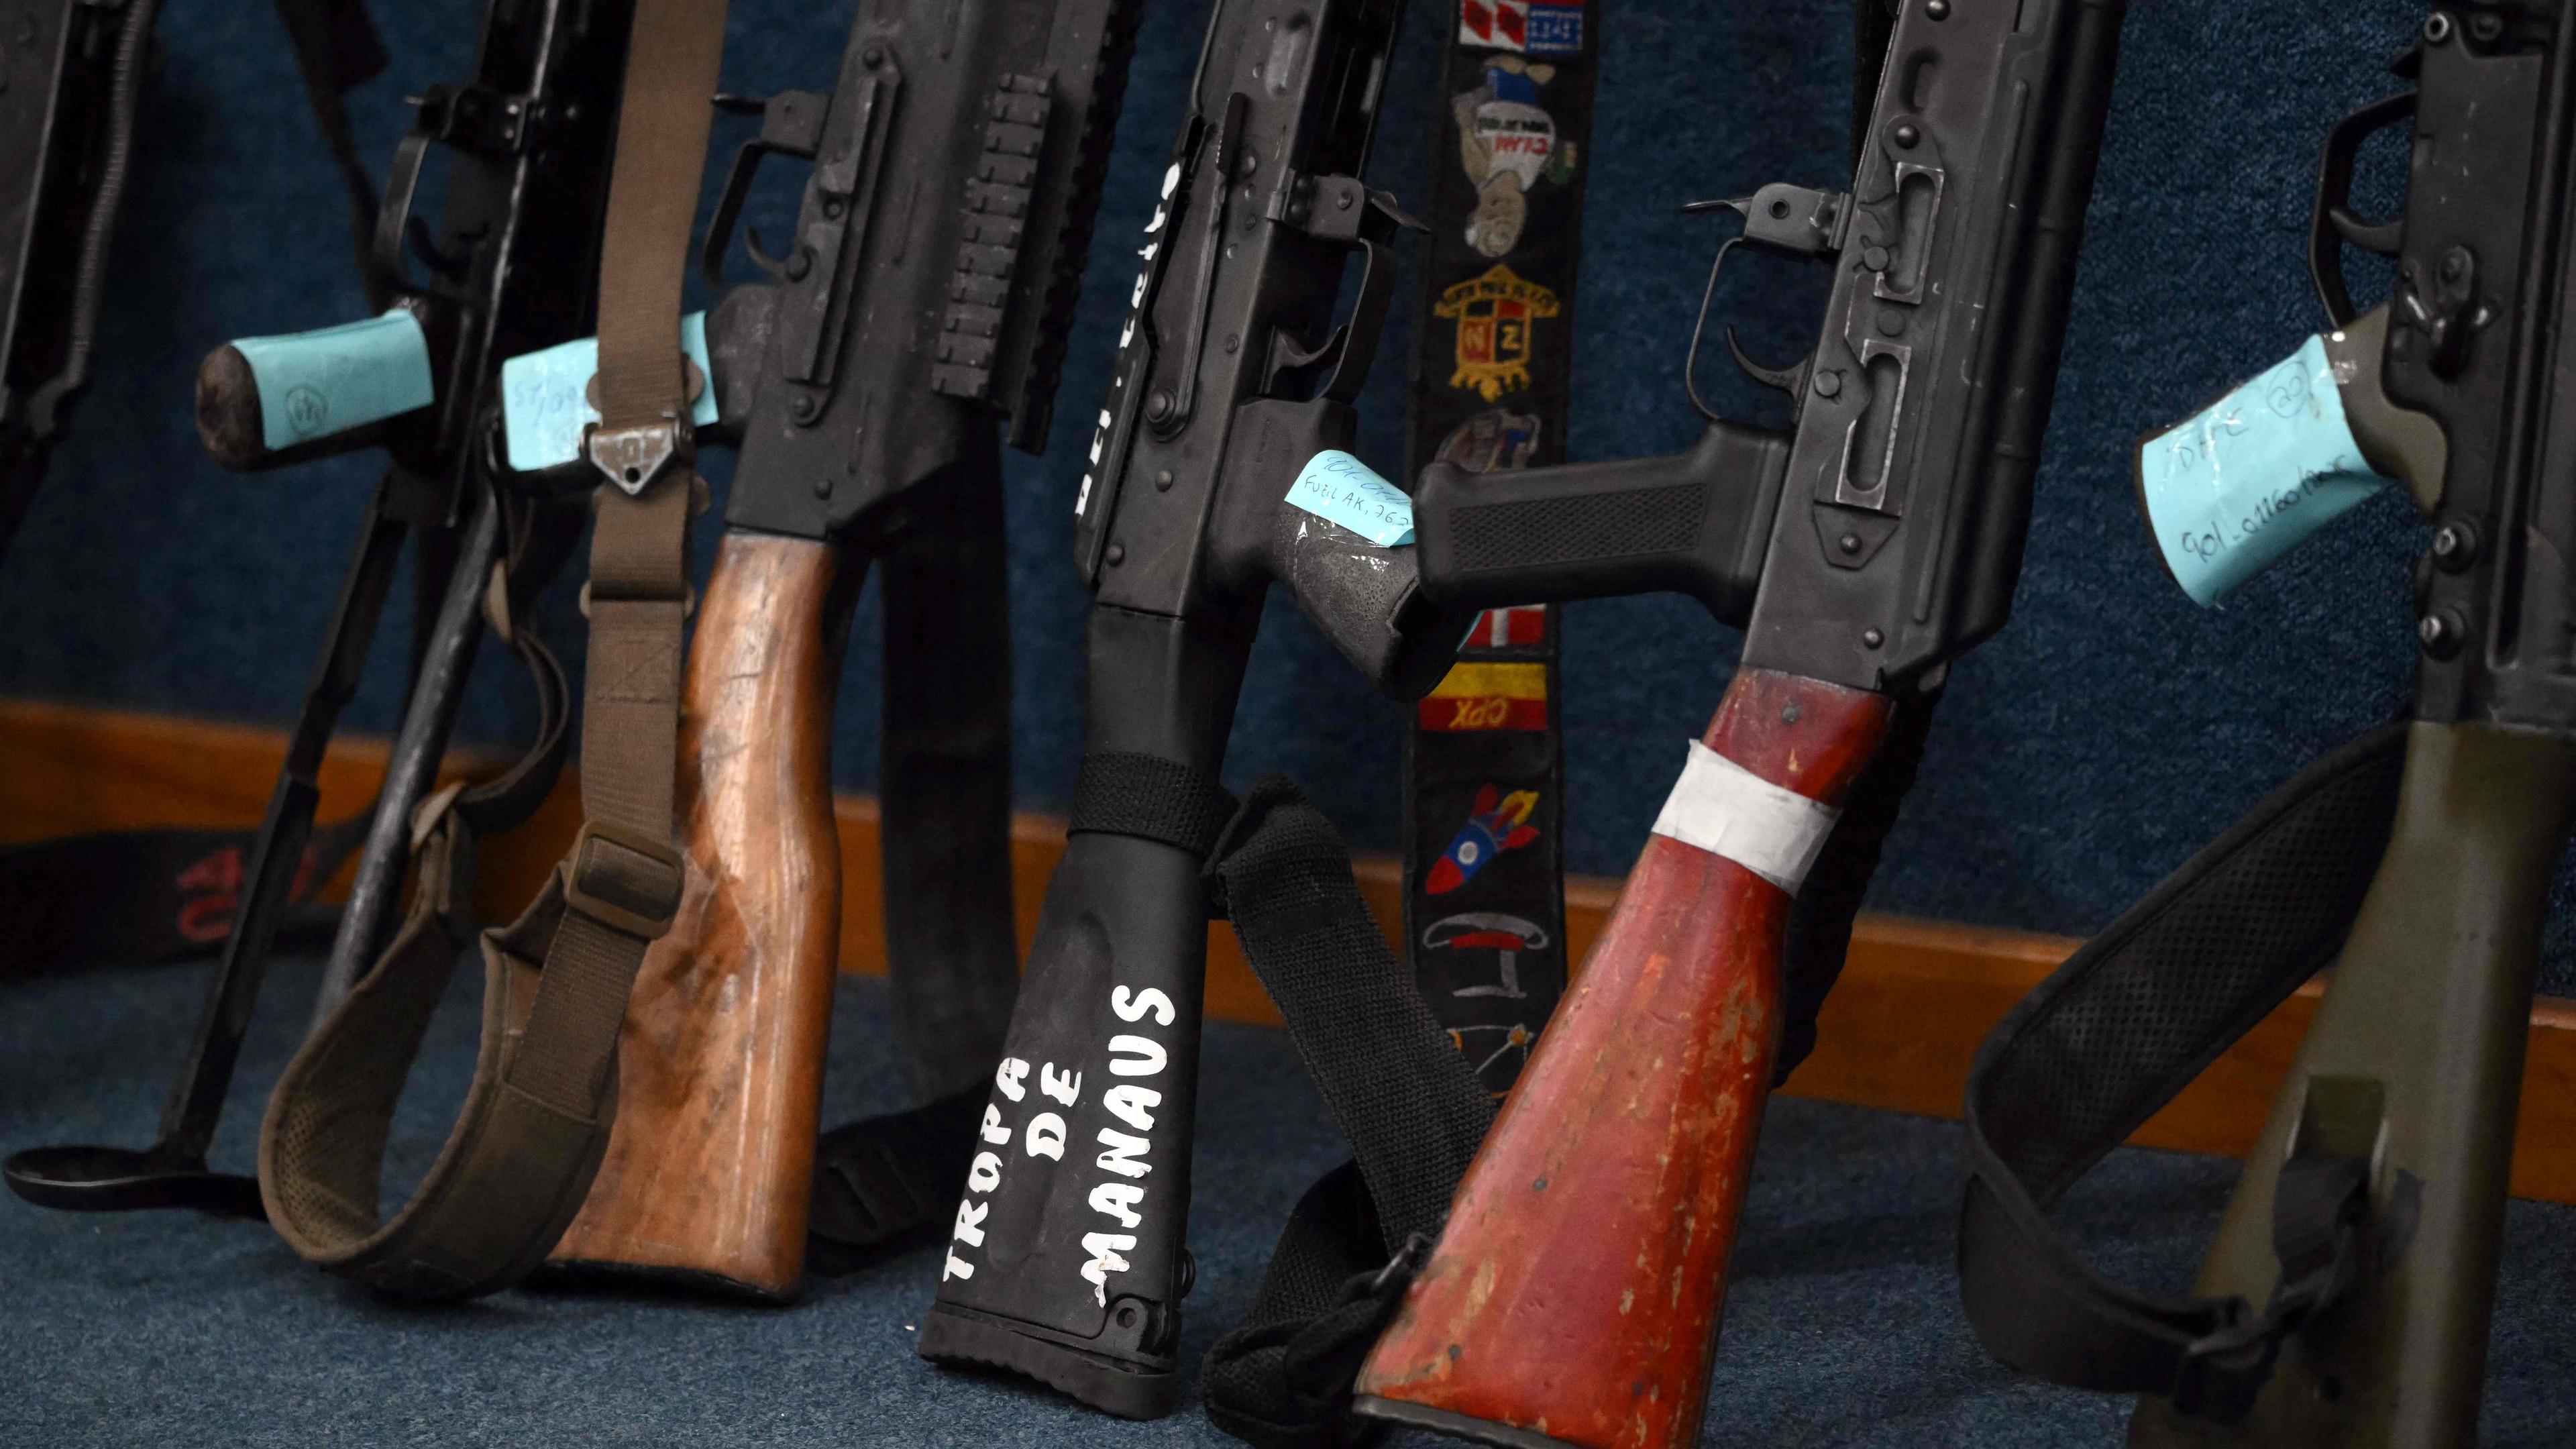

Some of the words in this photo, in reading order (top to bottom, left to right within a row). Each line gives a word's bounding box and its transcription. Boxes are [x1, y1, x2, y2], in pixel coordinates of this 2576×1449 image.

[943, 1058, 1030, 1282] TROPA
[1026, 1061, 1082, 1162] DE
[1081, 985, 1176, 1308] MANAUS
